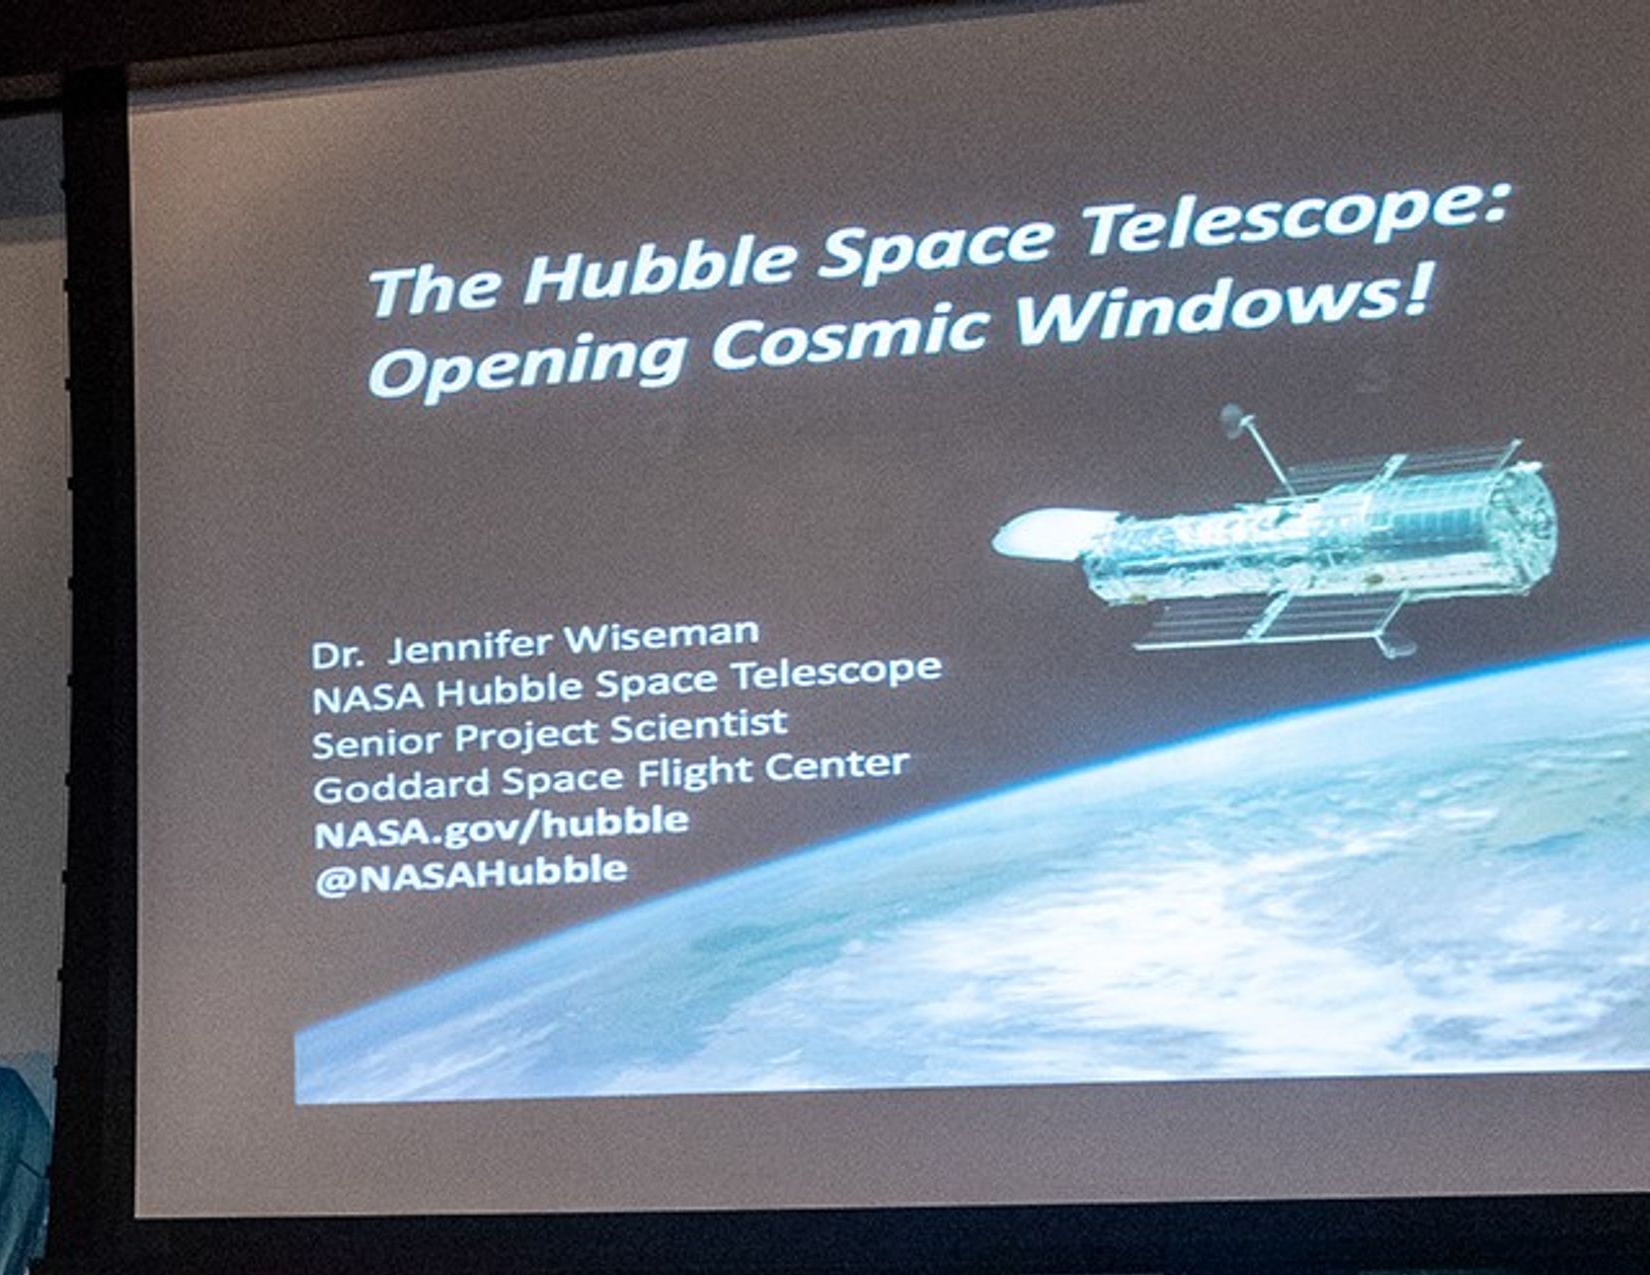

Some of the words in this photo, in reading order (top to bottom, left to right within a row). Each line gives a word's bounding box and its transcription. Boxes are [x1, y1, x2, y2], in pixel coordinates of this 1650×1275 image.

[368, 262, 503, 319] The
[522, 233, 800, 305] Hubble
[817, 221, 1057, 288] Space
[1081, 182, 1513, 256] Telescope:
[368, 330, 689, 407] Opening
[712, 300, 992, 371] Cosmic
[1017, 259, 1437, 347] Windows!
[311, 641, 366, 671] Dr.
[386, 627, 555, 667] Jennifer
[562, 620, 761, 655] Wiseman
[312, 681, 426, 716] NASA
[436, 670, 585, 709] Hubble
[594, 668, 720, 705] Space
[728, 655, 944, 691] Telescope
[311, 727, 444, 761] Senior
[455, 718, 601, 757] Project
[609, 706, 790, 745] Scientist
[312, 765, 491, 806] Goddard
[500, 765, 626, 802] Space
[637, 754, 755, 793] Flight
[764, 749, 913, 783] Center
[314, 802, 691, 851] NASA.gov/hubble
[315, 851, 630, 900] @NASAHubble
